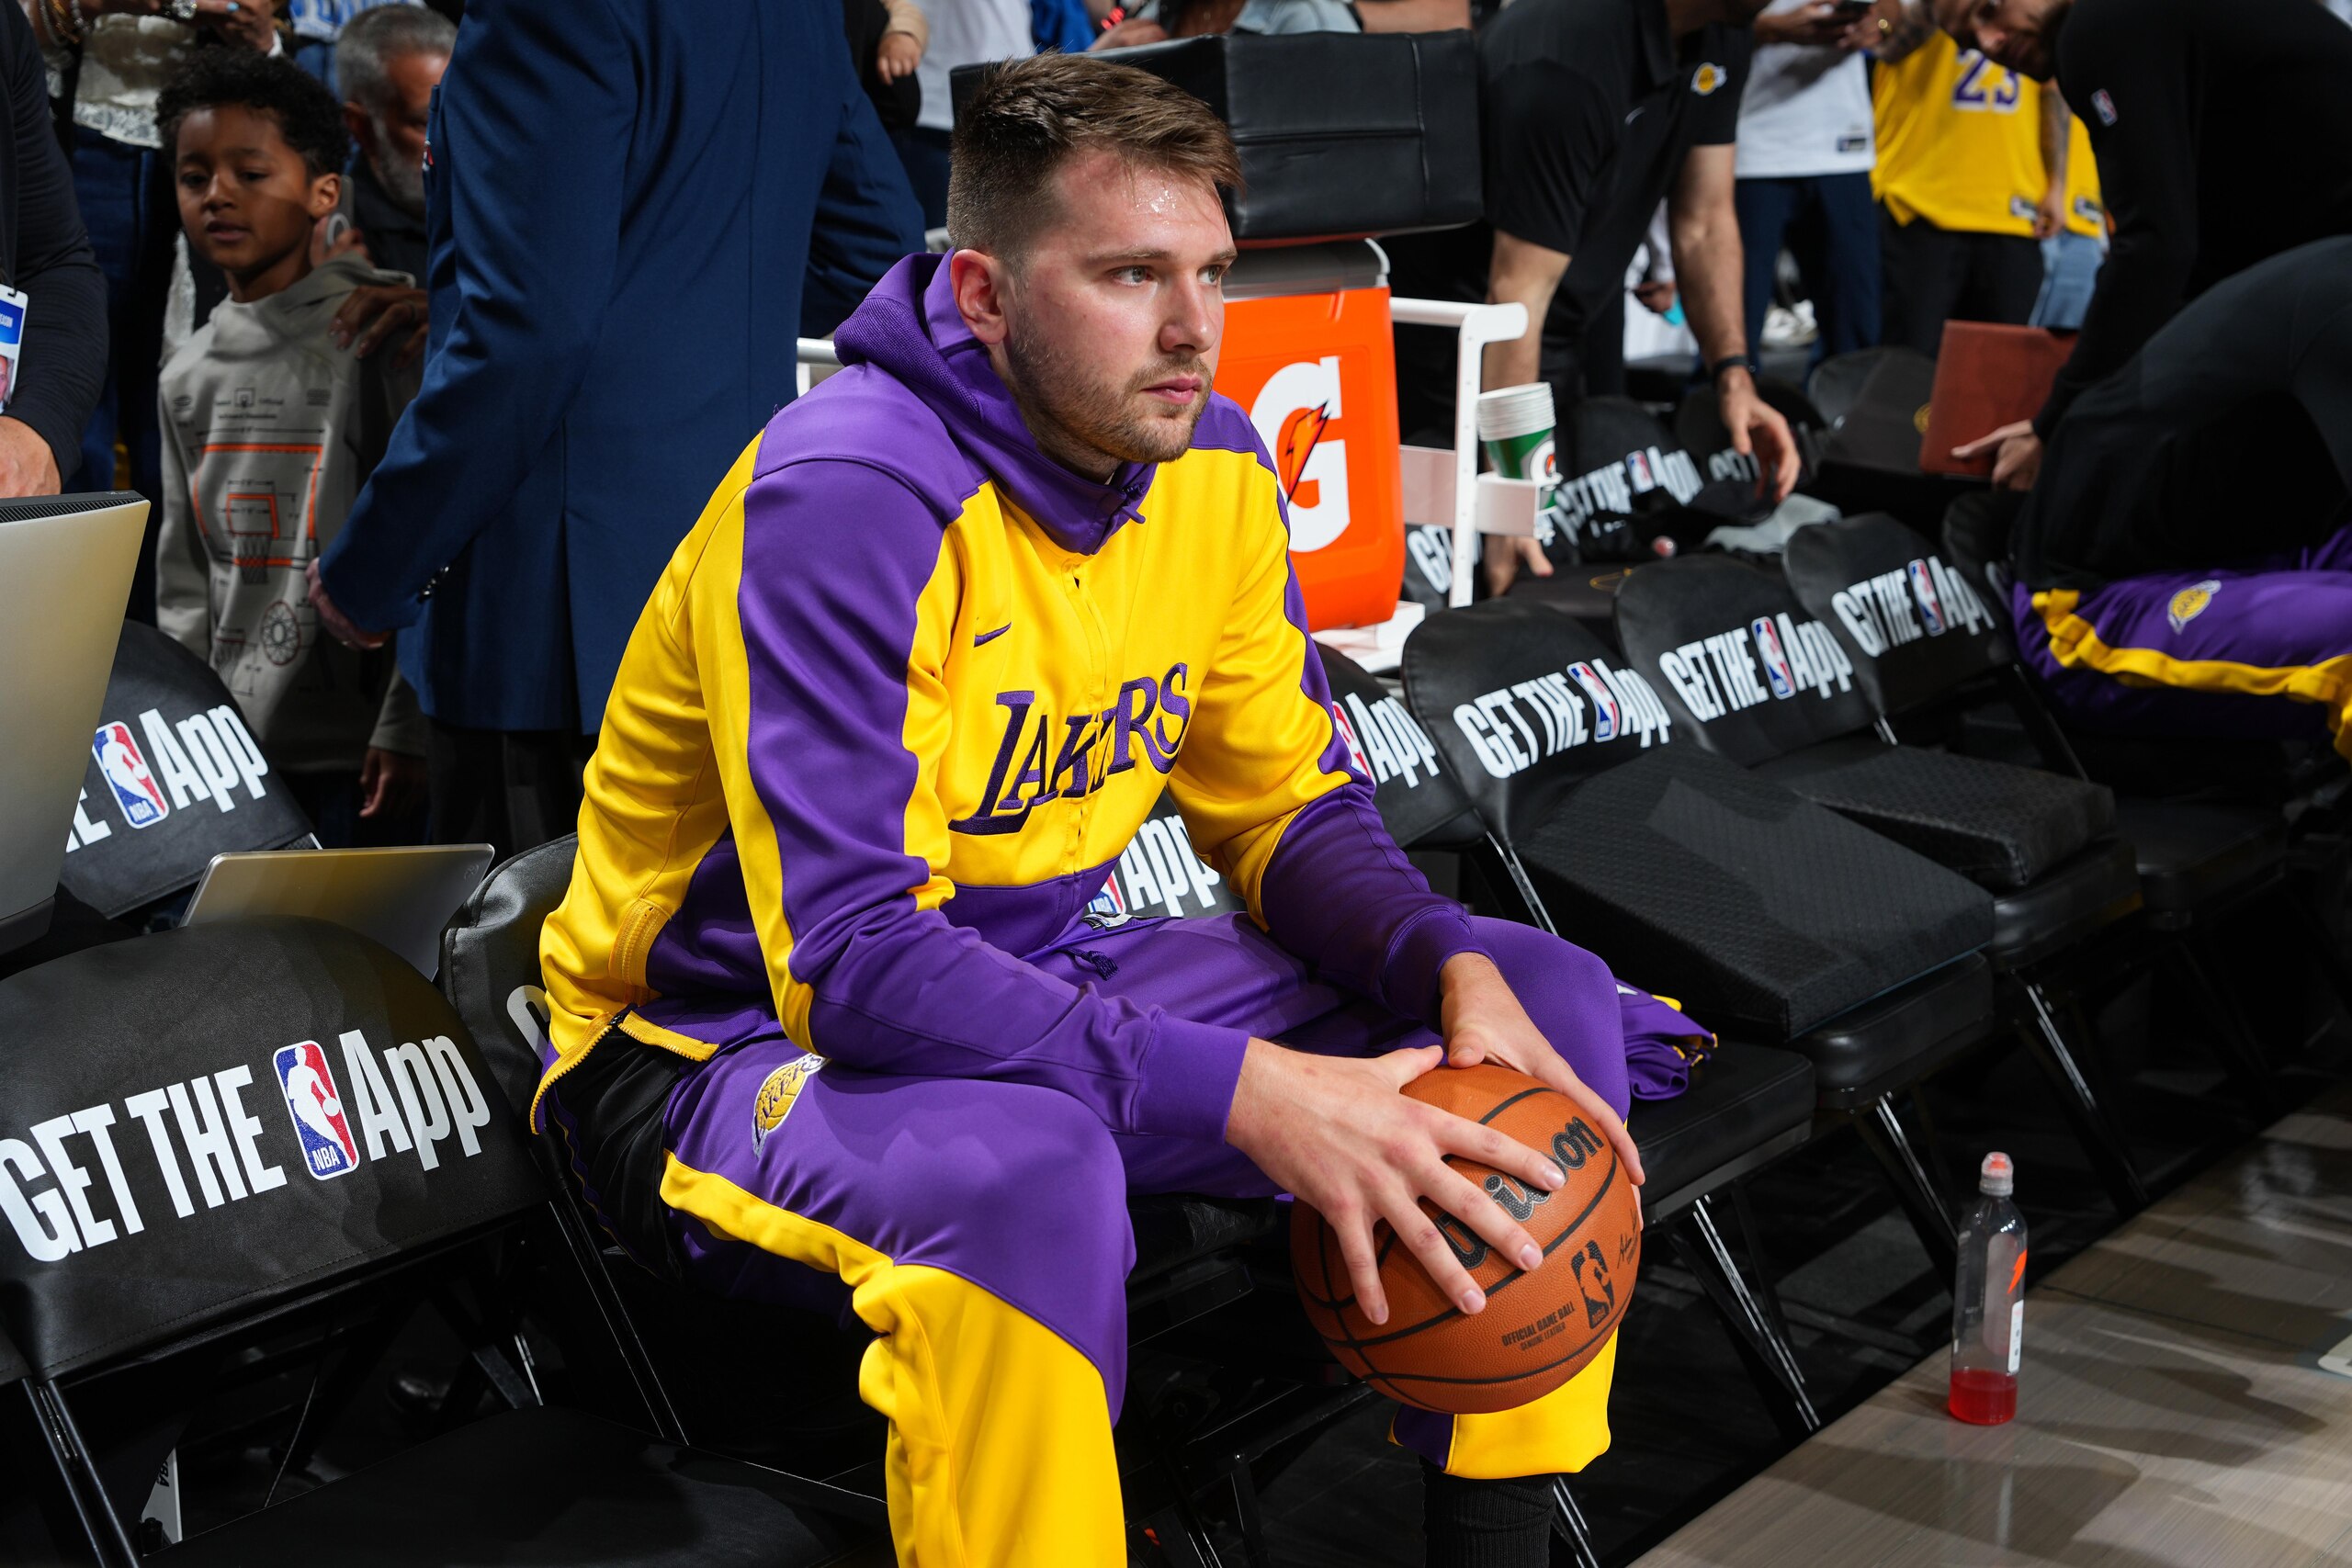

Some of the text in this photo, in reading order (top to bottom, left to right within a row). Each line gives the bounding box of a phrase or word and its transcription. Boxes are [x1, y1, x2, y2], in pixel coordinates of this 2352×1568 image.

[1871, 568, 1924, 647] THE
[1453, 658, 1671, 779] GET THE App
[1659, 612, 1853, 722] GET THE App
[139, 705, 268, 813] App
[1344, 692, 1441, 789] App
[0, 1029, 492, 1262] GET THE NBA App
[1501, 1301, 1576, 1347] OFFICIAL GAME BALL
